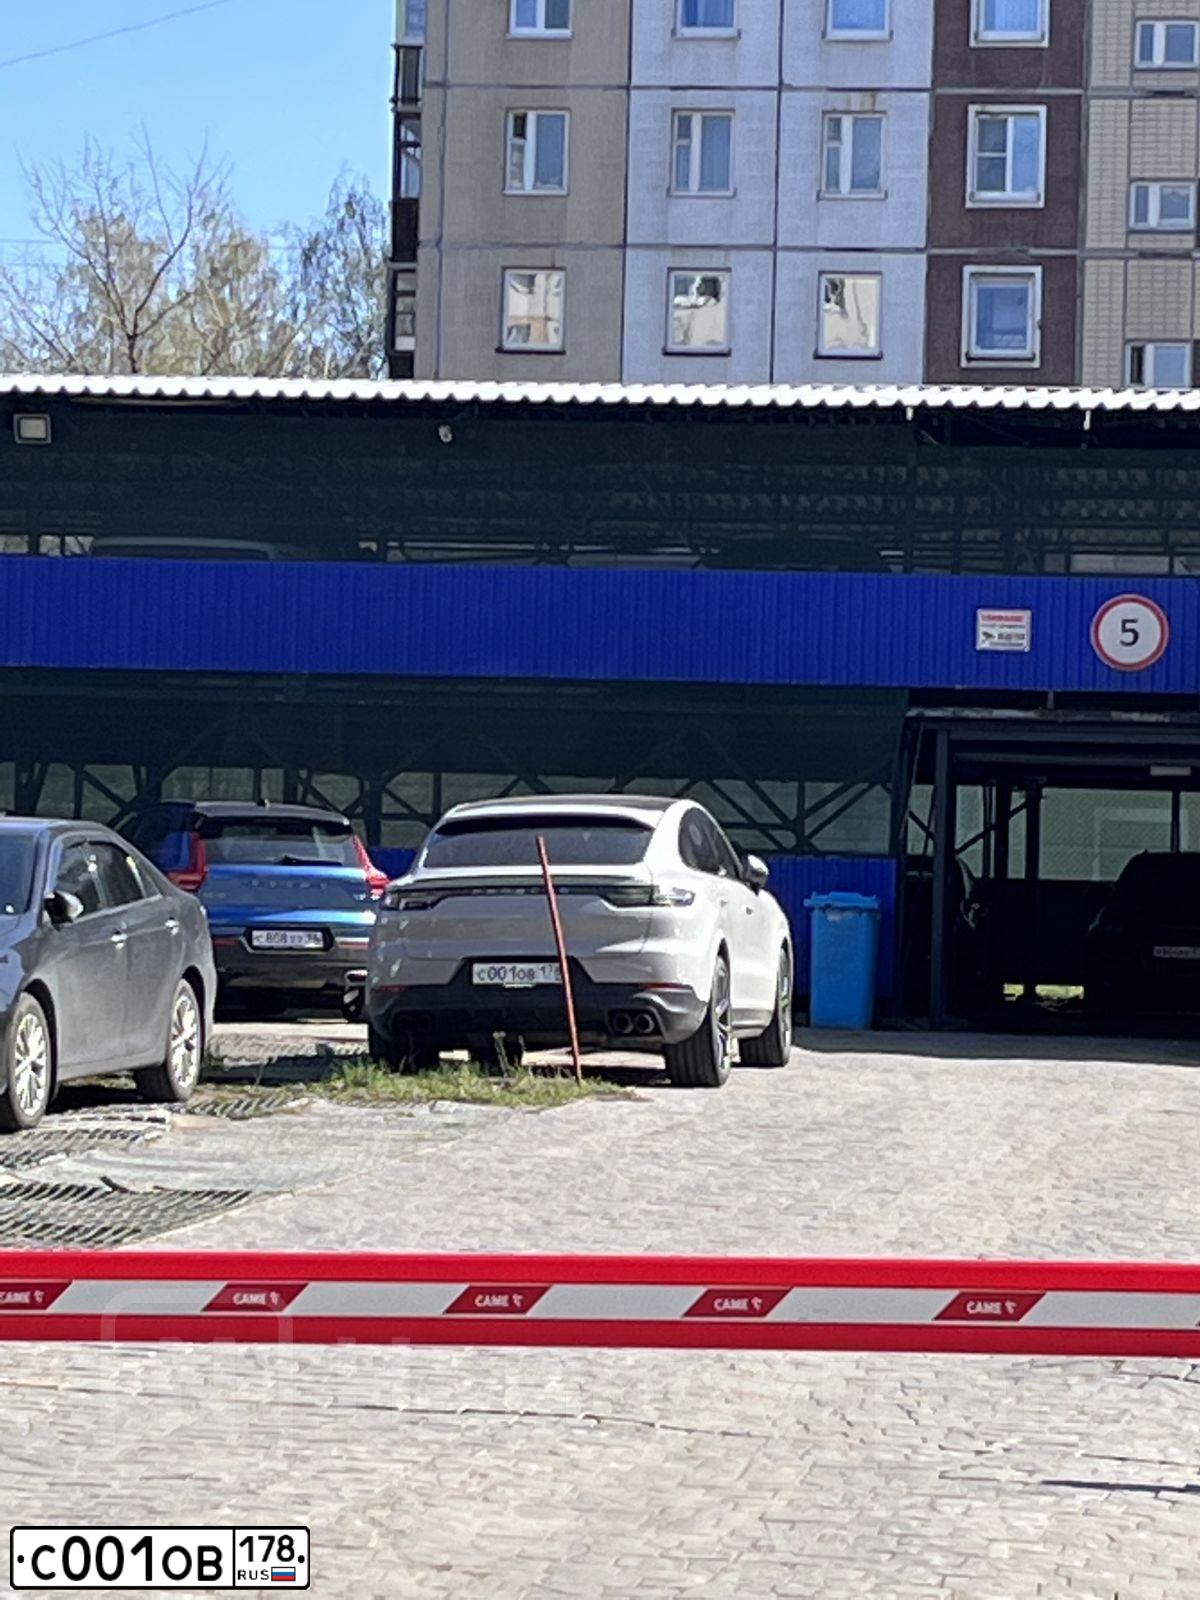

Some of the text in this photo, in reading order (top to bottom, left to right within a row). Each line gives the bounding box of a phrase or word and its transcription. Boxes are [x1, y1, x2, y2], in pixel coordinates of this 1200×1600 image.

[1119, 618, 1139, 647] 5
[474, 1294, 509, 1308] CAME
[713, 1298, 748, 1311] CAME
[966, 1301, 1002, 1314] CAME
